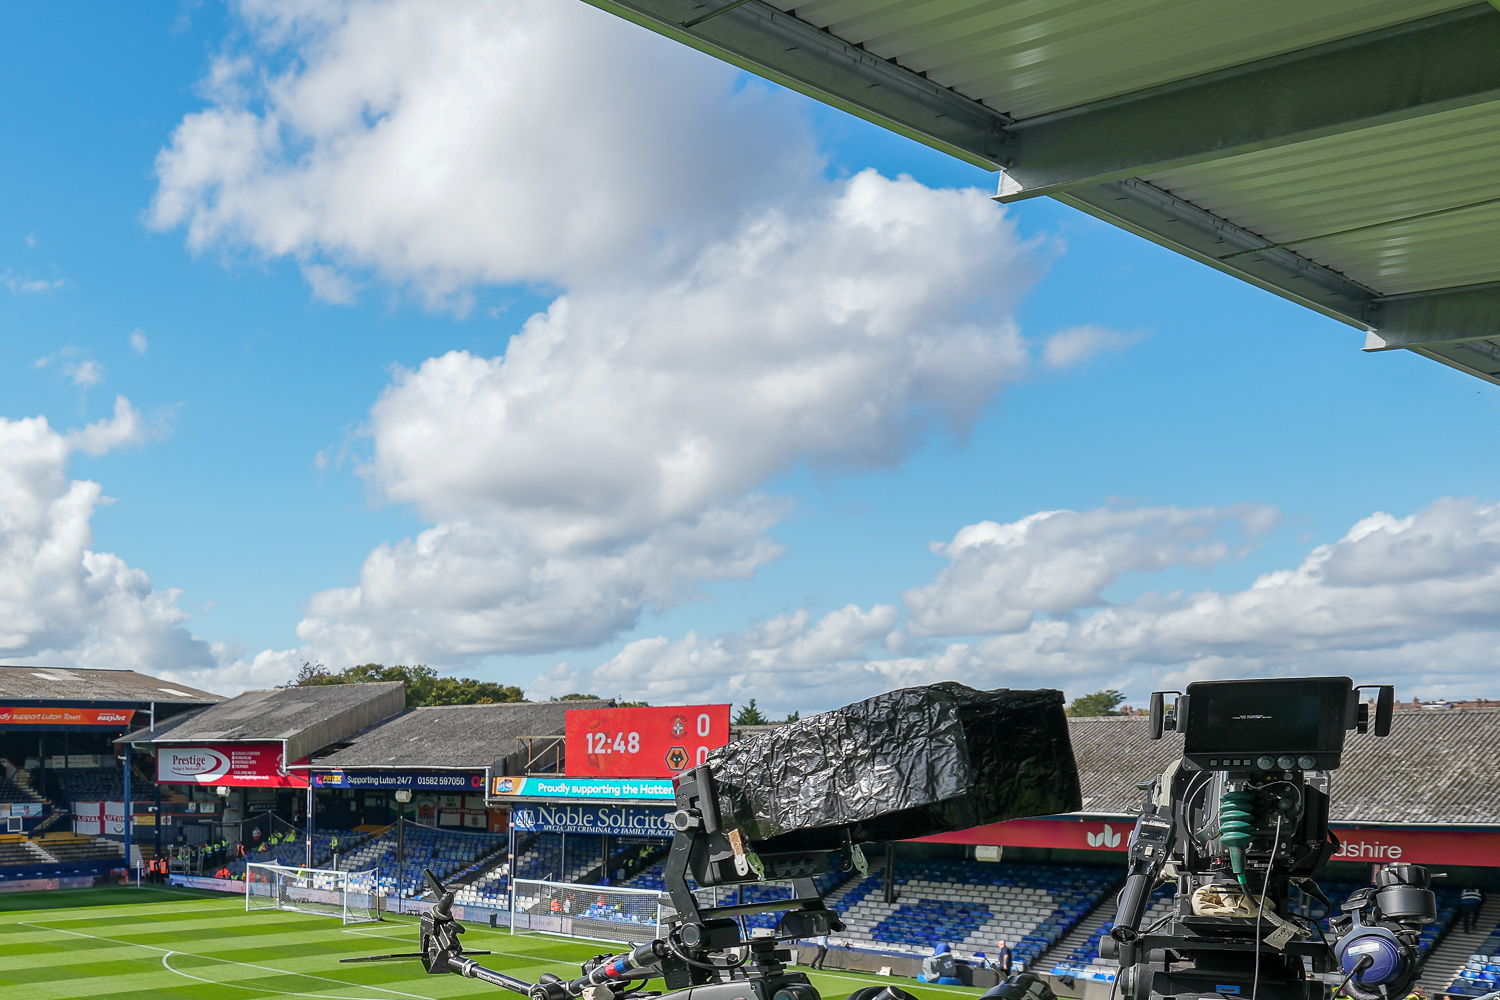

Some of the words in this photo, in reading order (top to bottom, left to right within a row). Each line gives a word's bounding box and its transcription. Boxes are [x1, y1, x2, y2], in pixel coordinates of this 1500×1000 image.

[97, 714, 127, 722] easyJet
[697, 713, 710, 737] 0
[586, 731, 640, 754] 12:48
[172, 755, 206, 767] Prestige
[347, 775, 379, 785] Supporting
[379, 776, 396, 785] Luton
[397, 776, 413, 785] 24/7
[417, 777, 438, 785] 01582
[439, 777, 465, 786] 597050
[538, 783, 570, 795] Proudly
[571, 784, 621, 796] supporting
[621, 784, 638, 794] the
[537, 806, 594, 827] Noble
[543, 824, 577, 832] SPECIALIST
[577, 826, 613, 834] CRIMINAL
[647, 829, 676, 837] PRACTIC
[1338, 841, 1402, 859] dshire
